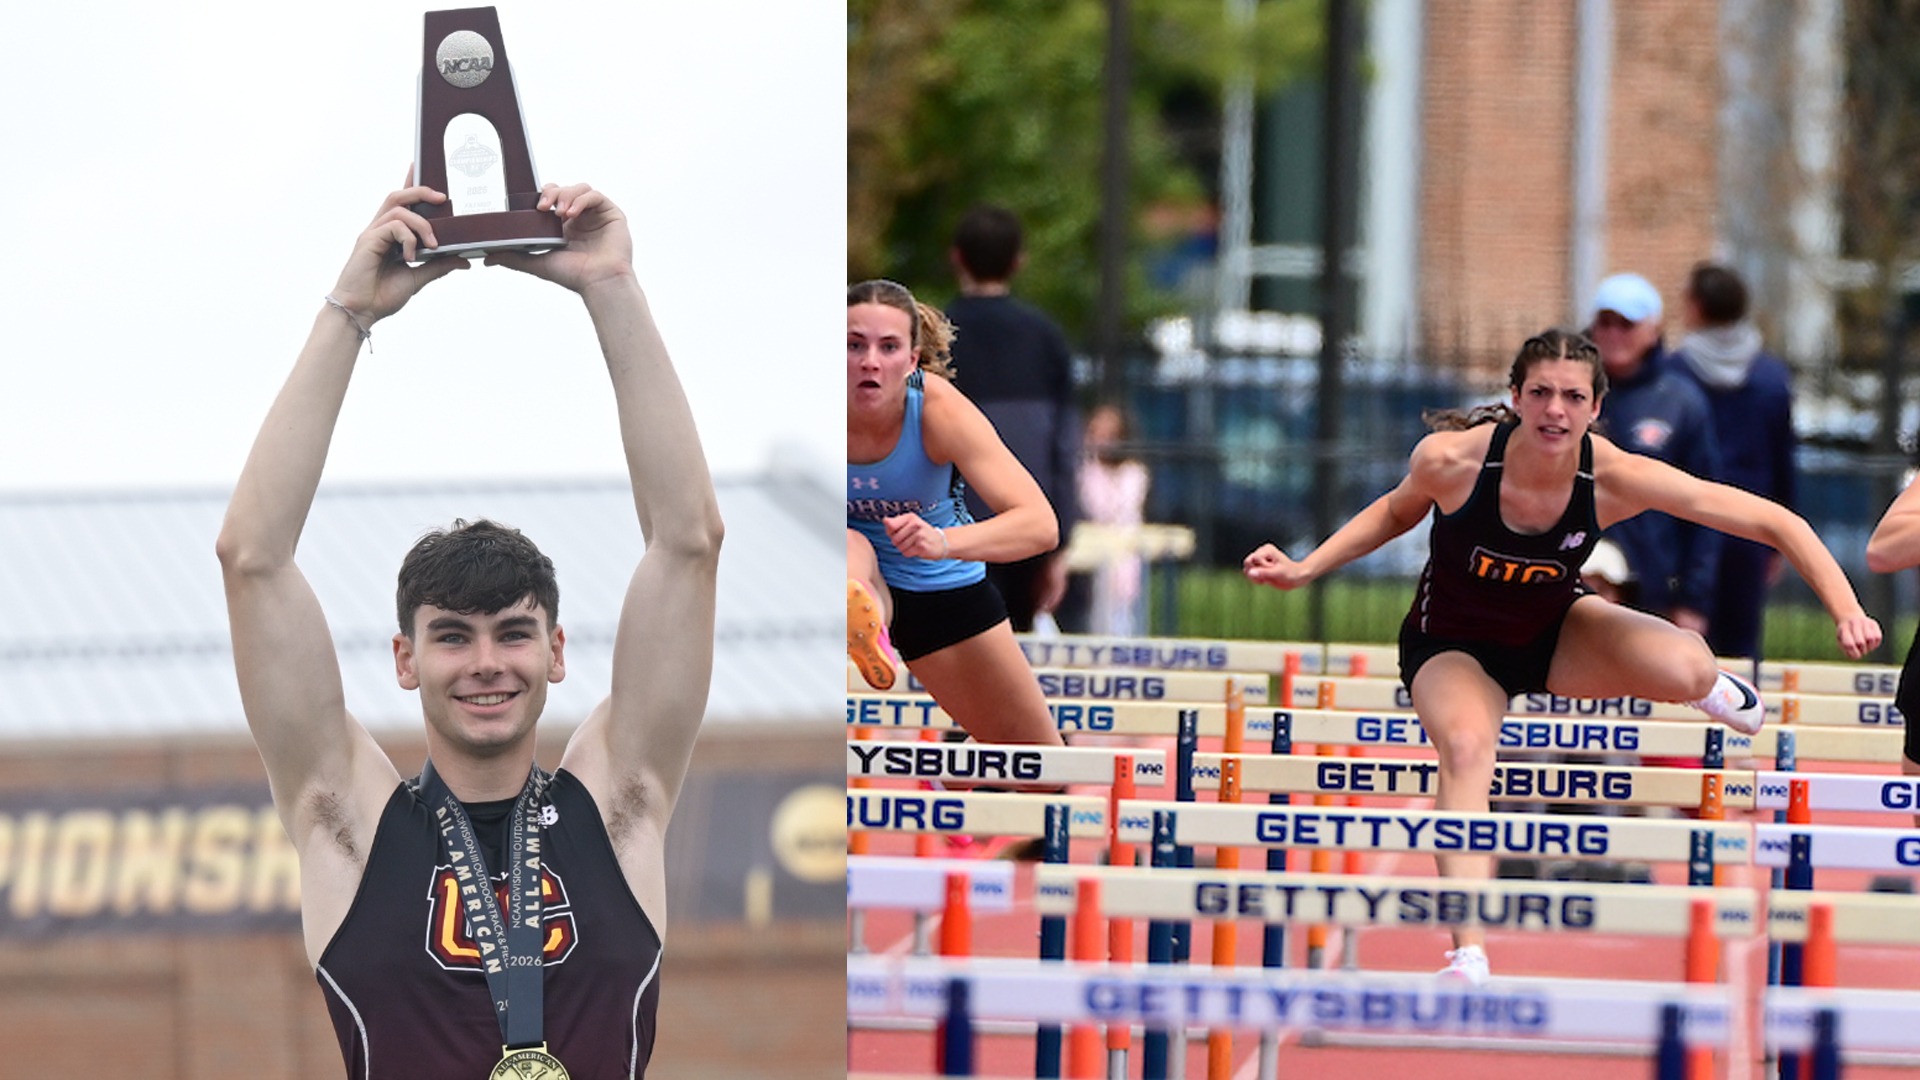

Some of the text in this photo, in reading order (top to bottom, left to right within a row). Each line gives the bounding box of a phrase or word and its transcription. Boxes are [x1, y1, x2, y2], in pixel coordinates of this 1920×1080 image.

[443, 56, 493, 74] NCAA
[1020, 641, 1228, 667] TTYSBURG
[1356, 717, 1639, 750] GETSBURG
[850, 746, 1042, 780] YSBURG
[1317, 762, 1632, 799] GETTBURG
[1256, 812, 1609, 855] GETTYSBURG
[0, 805, 301, 917] IONSH
[457, 816, 477, 854] DIVISION
[473, 861, 495, 909] OUTDOOR
[489, 908, 504, 938] TRACK
[512, 861, 522, 901] DIVISION
[512, 902, 522, 928] NCAA
[1195, 882, 1596, 928] GETTYSBURG
[510, 956, 542, 967] 2026
[1086, 980, 1550, 1028] GETTYSBURG
